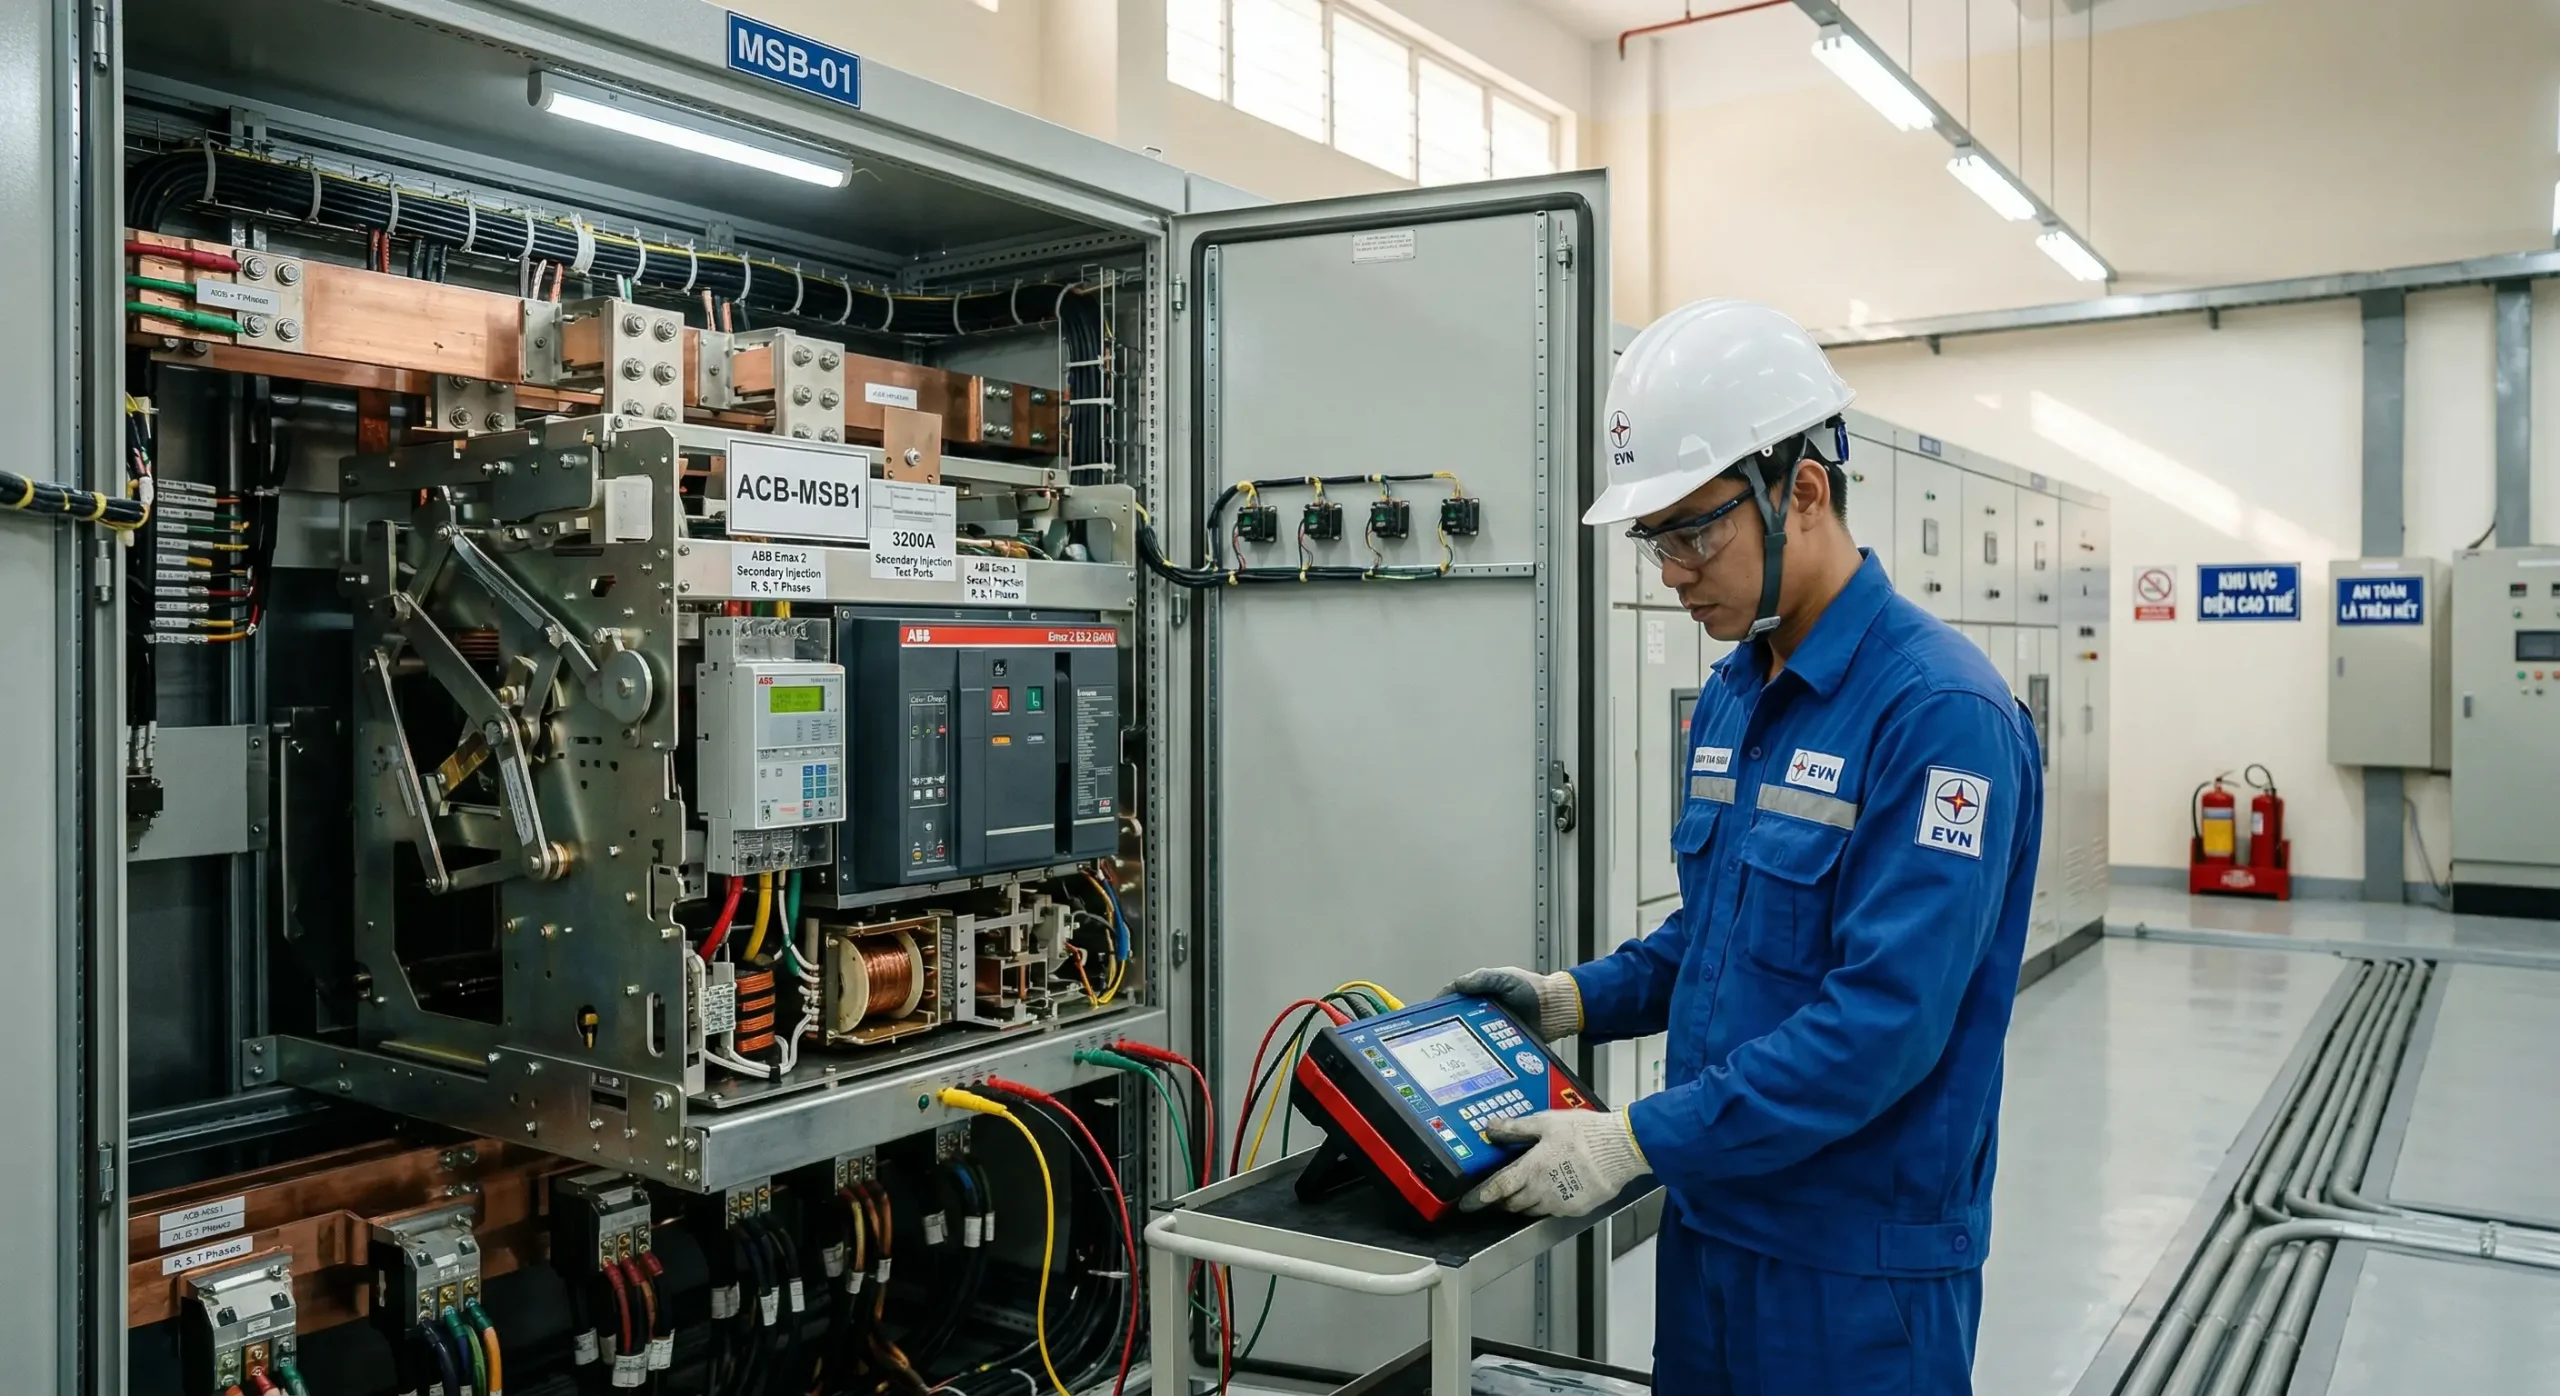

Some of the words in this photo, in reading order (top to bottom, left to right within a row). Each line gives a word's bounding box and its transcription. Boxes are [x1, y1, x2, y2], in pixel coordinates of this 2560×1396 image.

[738, 27, 850, 94] MSB-01
[1614, 450, 1635, 466] EVN
[736, 473, 860, 509] ACB-MSB1
[892, 531, 936, 549] 3200A
[751, 550, 773, 562] ABB
[774, 551, 800, 563] Emax
[800, 552, 807, 564] 2
[919, 555, 953, 568] Injection
[737, 565, 784, 580] Secondary
[785, 567, 821, 580] Injection
[913, 567, 934, 578] Ports
[773, 581, 779, 592] T
[781, 581, 812, 593] Phases
[2352, 584, 2371, 600] AN
[1807, 763, 1837, 782] EVN
[1930, 826, 1973, 848] EVN
[197, 1253, 203, 1262] T
[205, 1244, 242, 1261] Phases
